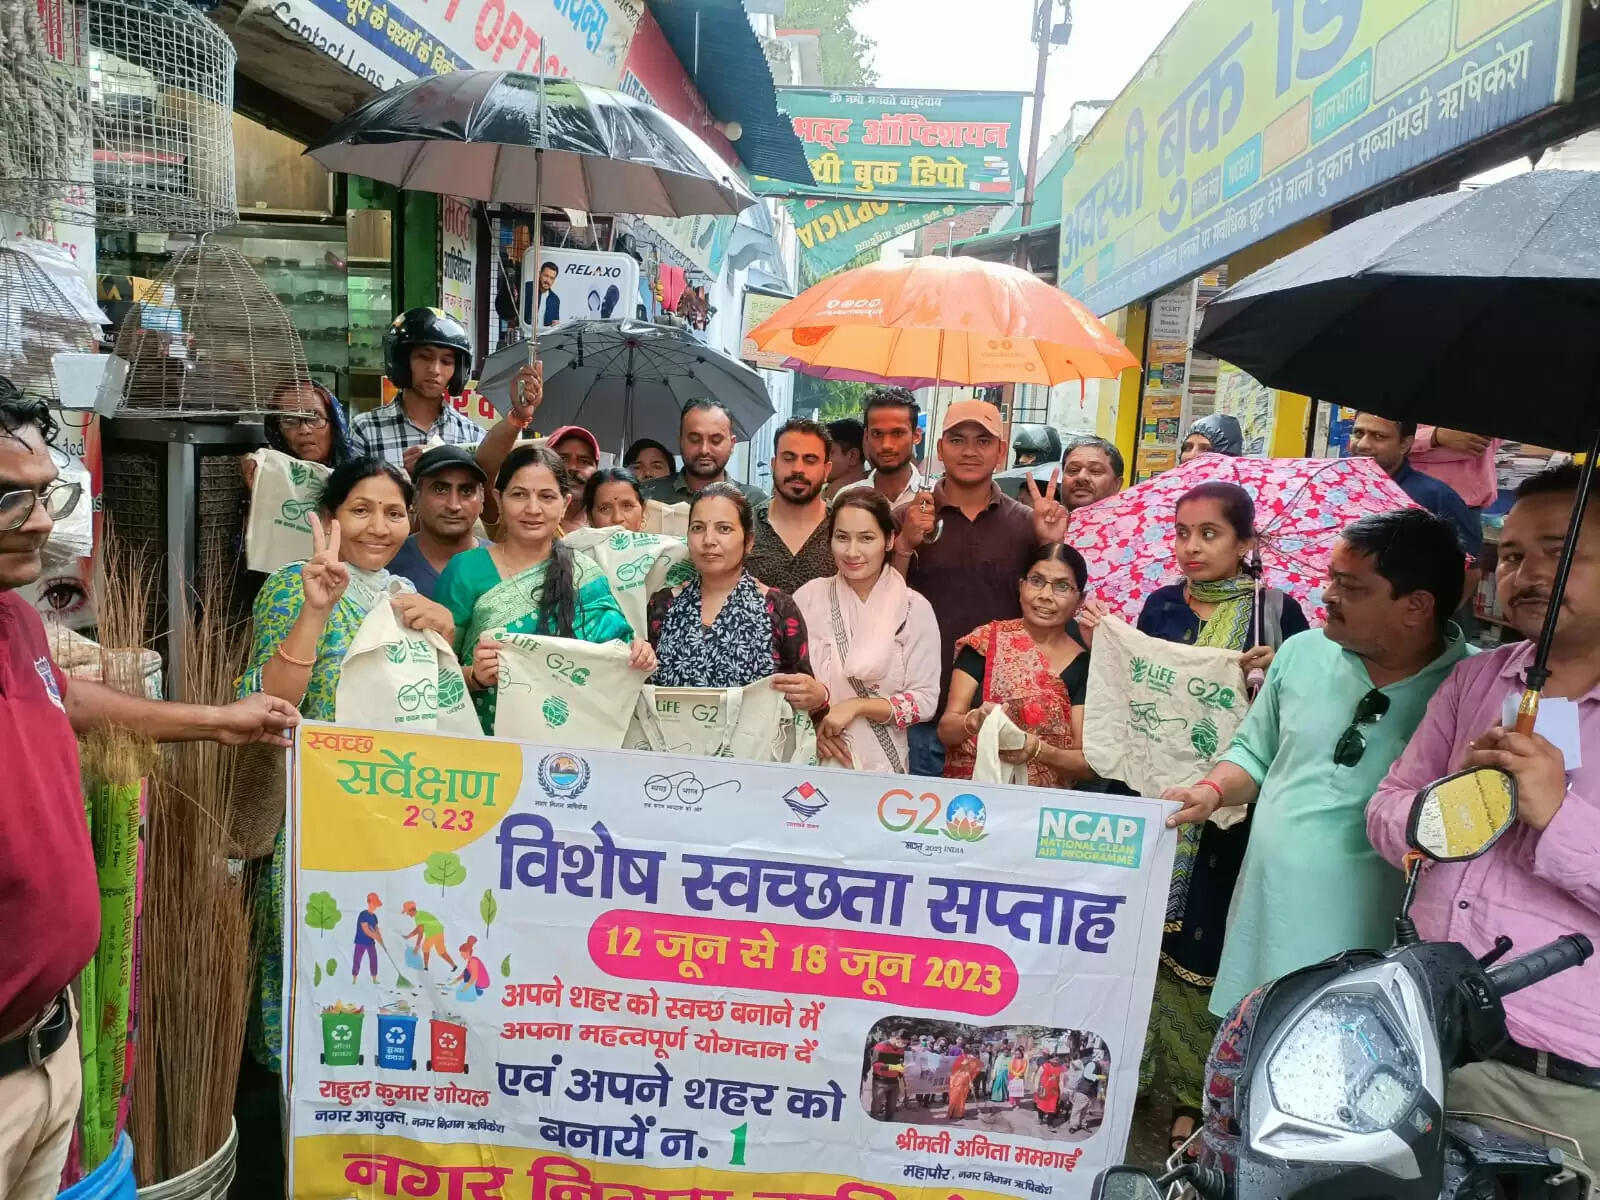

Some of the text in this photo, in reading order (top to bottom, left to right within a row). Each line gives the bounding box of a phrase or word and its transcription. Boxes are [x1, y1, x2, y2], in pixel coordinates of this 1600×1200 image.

[345, 49, 385, 89] Lens
[1156, 22, 1253, 232] बुक
[852, 159, 901, 193] बुक
[909, 155, 968, 188] डिपो
[1060, 107, 1147, 268] अवस्थी
[1317, 143, 1355, 198] दुकान
[564, 263, 622, 278] RELAXO
[512, 633, 542, 652] LiFE
[1147, 663, 1177, 685] LiFE
[656, 700, 681, 713] LiFE
[692, 703, 719, 723] G2
[306, 730, 375, 754] स्वच्छ
[336, 749, 501, 807] सर्वेक्षण
[1042, 811, 1138, 844] NCAP
[924, 845, 942, 854] 2023
[943, 845, 964, 854] INDIA
[1038, 847, 1135, 865] AIR PROGRAMME
[1040, 837, 1137, 855] NATIONAL CLEAN
[495, 812, 1127, 954] विशेष स्वच्छता सप्ताह
[605, 925, 1002, 996] 12 जून से 18 जून 2023
[501, 975, 826, 1032] अपने शहर को स्वच्छ बनाने में
[500, 1021, 819, 1064] अपना महत्वपूर्ण योगदान दें
[318, 1080, 491, 1108] राहुल कुमार गोयल
[496, 1053, 563, 1097] एवं
[564, 1061, 673, 1108] अपने
[683, 1073, 779, 1114] शहर
[786, 1079, 847, 1123] को
[314, 1109, 351, 1123] नगर
[411, 1116, 435, 1129] नगर
[436, 1116, 466, 1131] निगम
[539, 1113, 749, 1166] बनायें न. 1
[895, 1128, 1083, 1174] श्रीमती अनिता ममगाईं
[958, 1169, 982, 1184] नगर
[983, 1169, 1013, 1188] निगम
